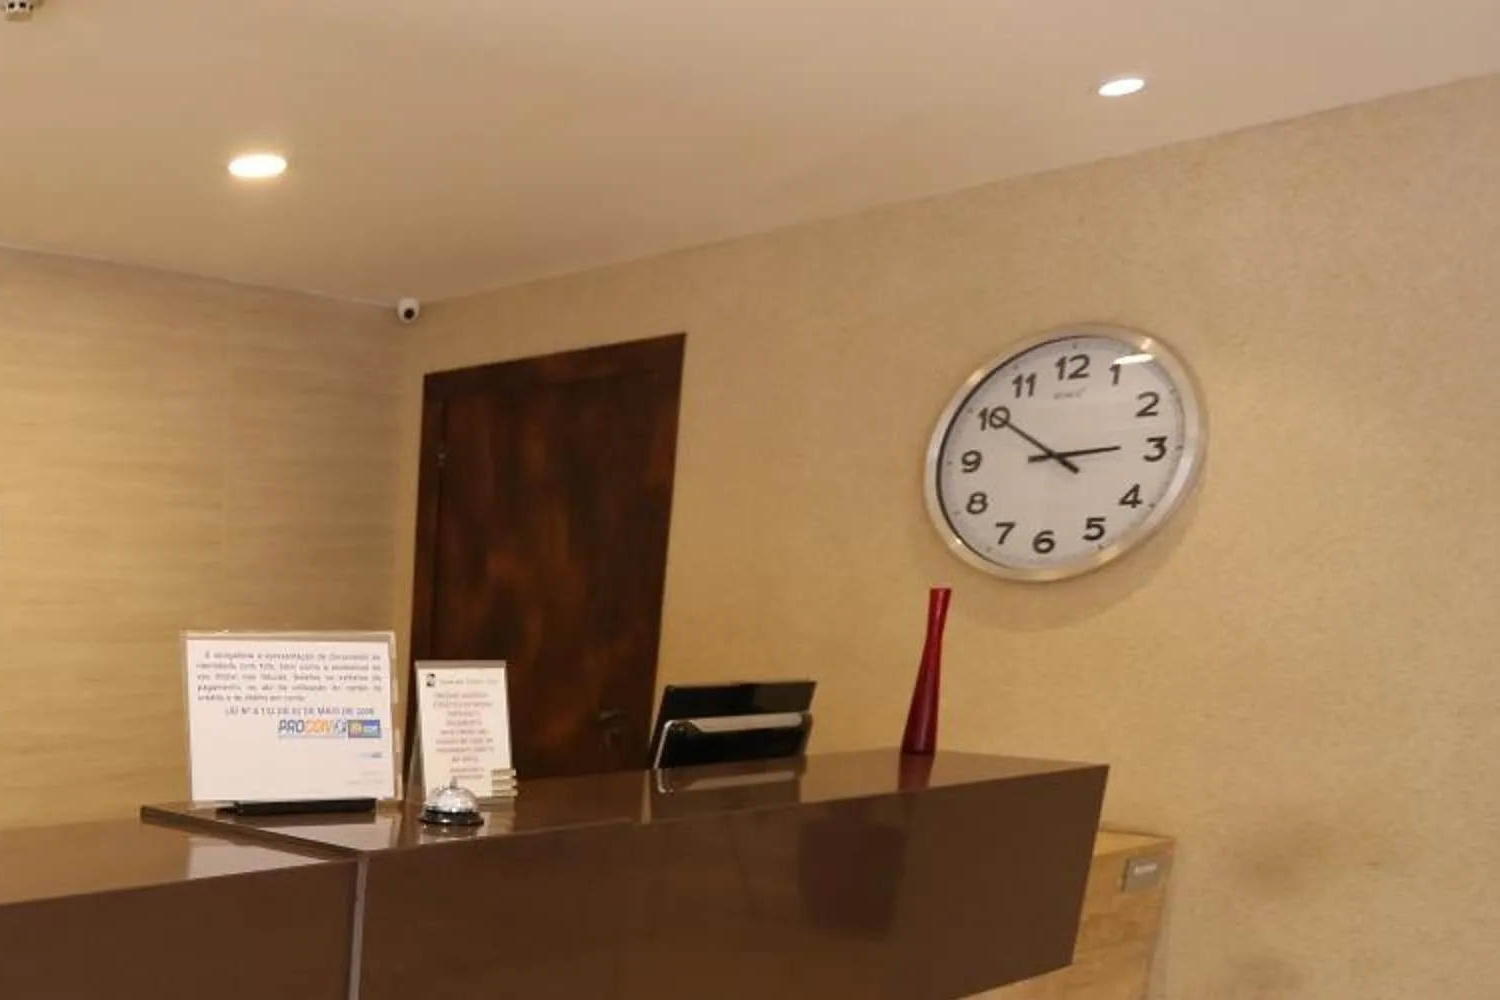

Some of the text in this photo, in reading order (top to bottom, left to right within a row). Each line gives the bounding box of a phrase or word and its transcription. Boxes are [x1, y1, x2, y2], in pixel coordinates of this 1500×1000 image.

[1055, 354, 1090, 380] 12
[1109, 364, 1122, 386] 1
[1012, 373, 1037, 398] 11
[1136, 392, 1160, 417] 2
[978, 406, 1011, 431] 10
[1143, 436, 1167, 462] 3
[961, 450, 982, 473] 9
[966, 492, 988, 514] 8
[1119, 484, 1142, 508] 4
[996, 522, 1016, 544] 7
[1082, 517, 1105, 540] 5
[1032, 530, 1055, 554] 6
